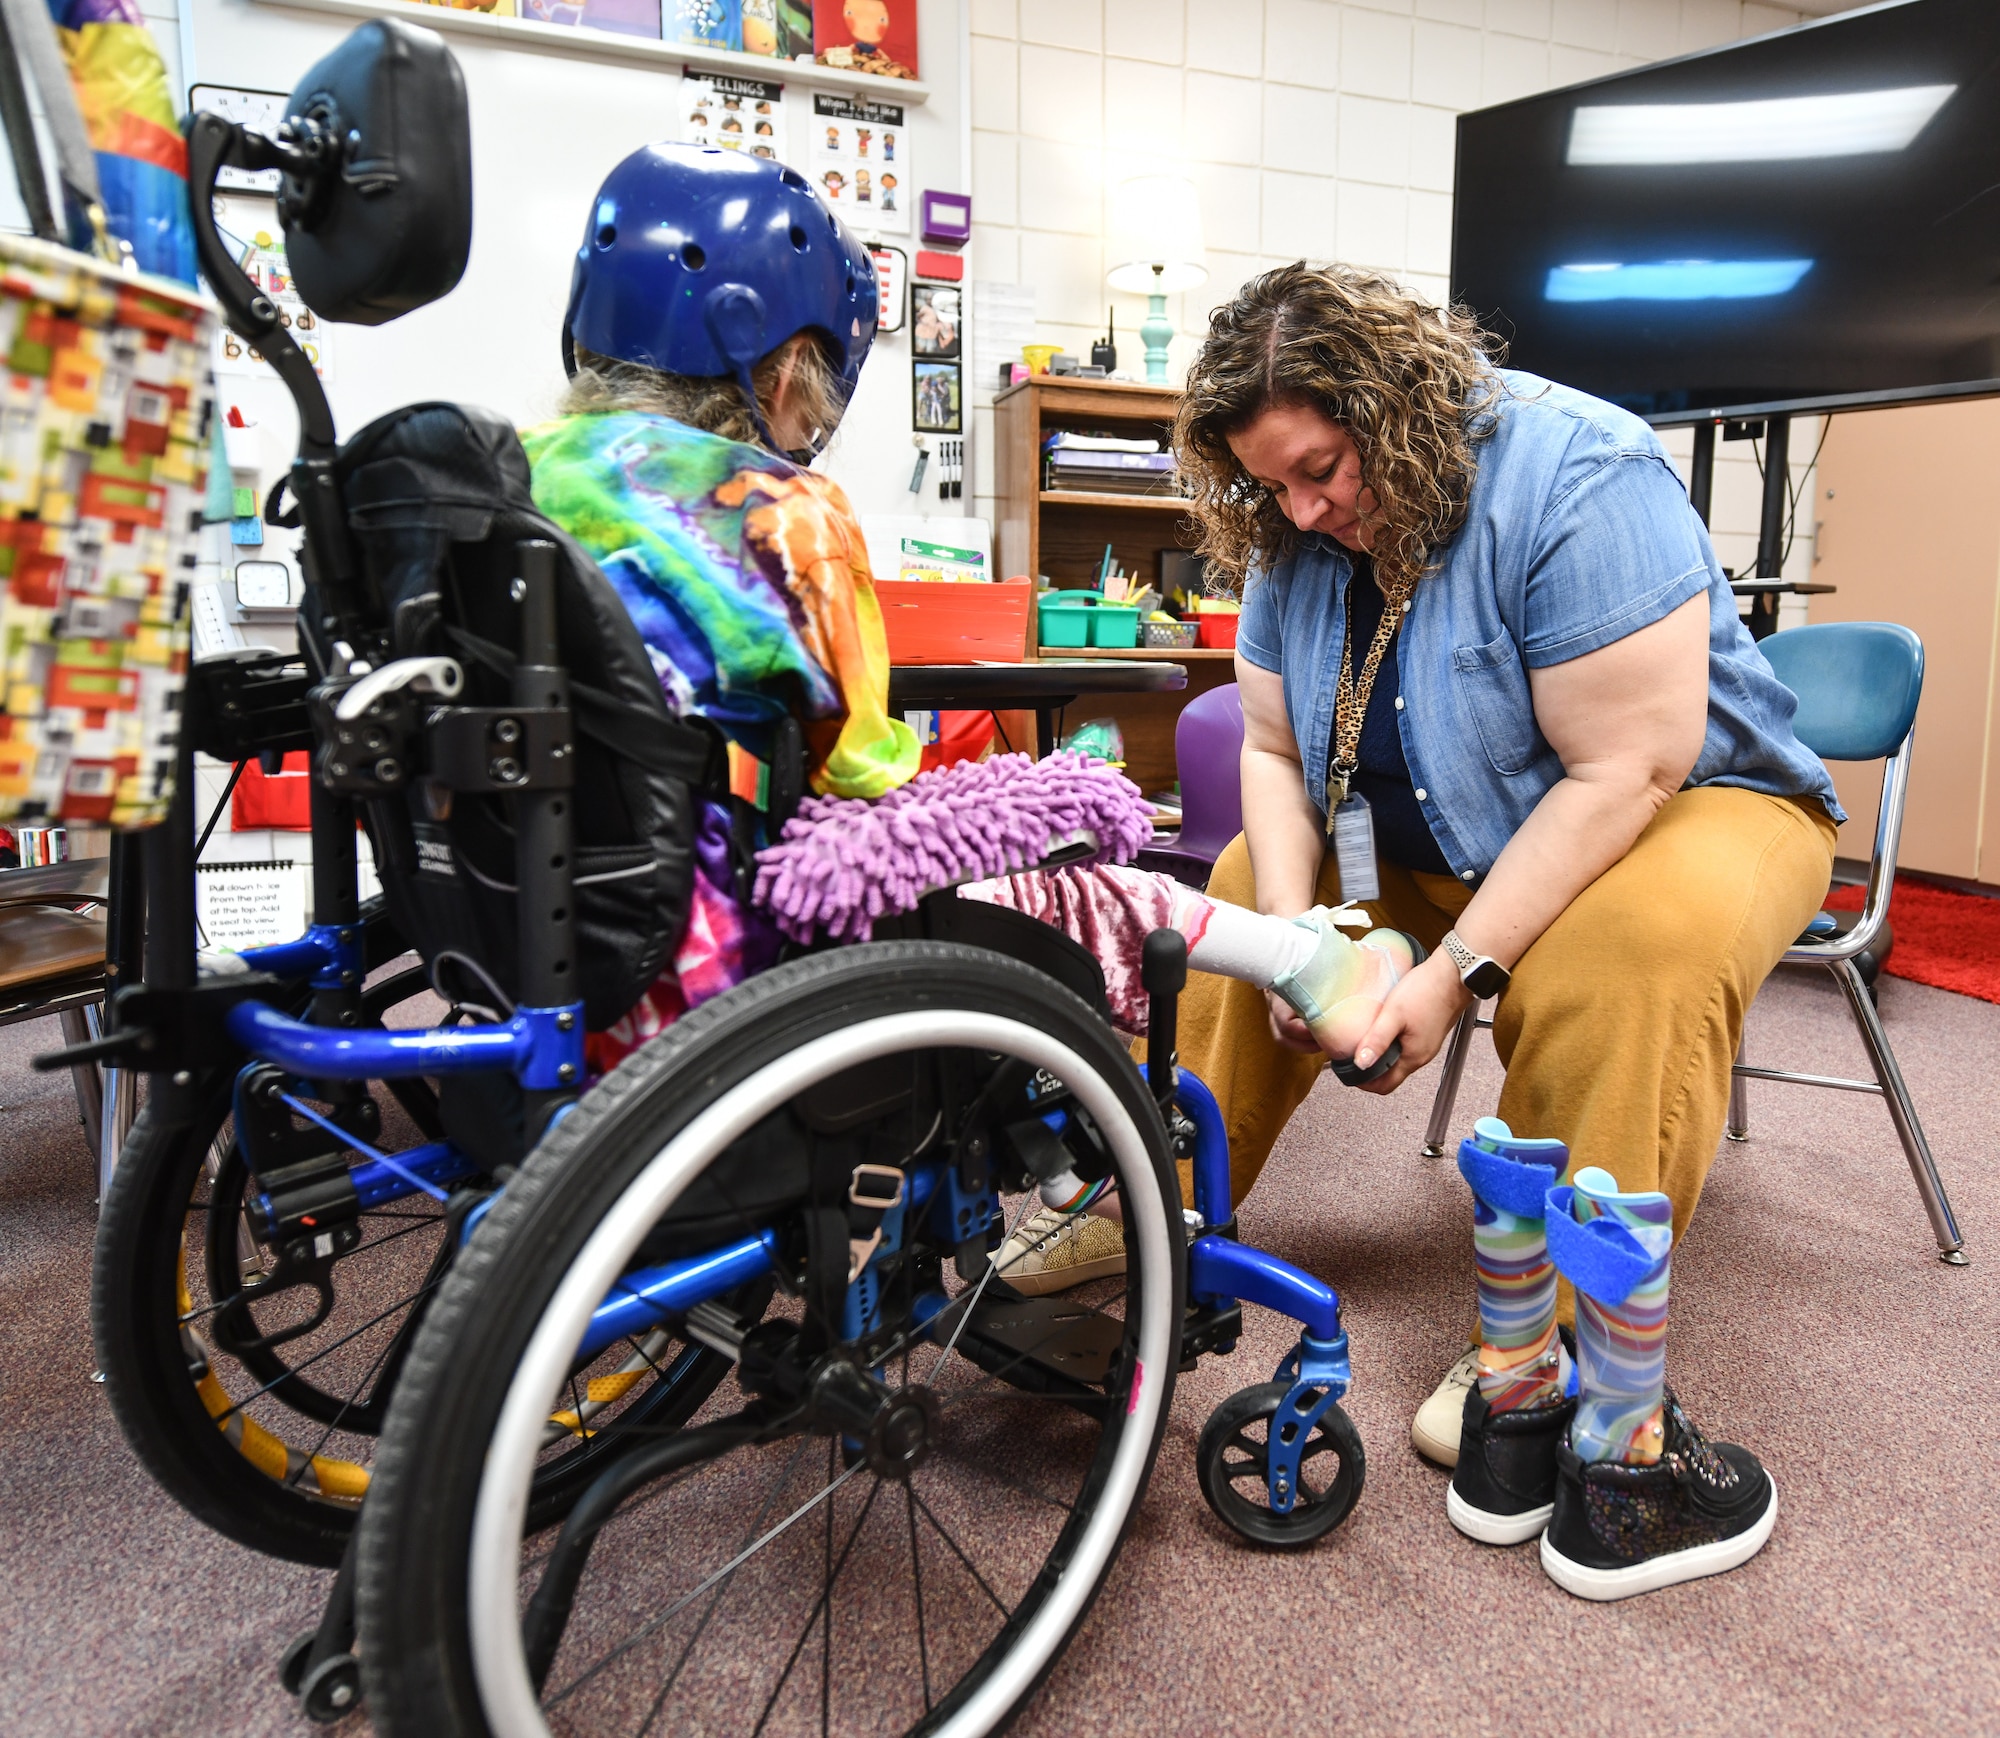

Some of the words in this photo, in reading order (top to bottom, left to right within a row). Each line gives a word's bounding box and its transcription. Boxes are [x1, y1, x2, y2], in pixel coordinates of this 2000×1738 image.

[819, 96, 848, 109] When
[880, 105, 899, 117] like
[209, 884, 225, 892] Pull
[227, 883, 254, 891] down
[254, 893, 277, 903] point
[243, 917, 252, 925] to
[228, 929, 255, 938] apple
